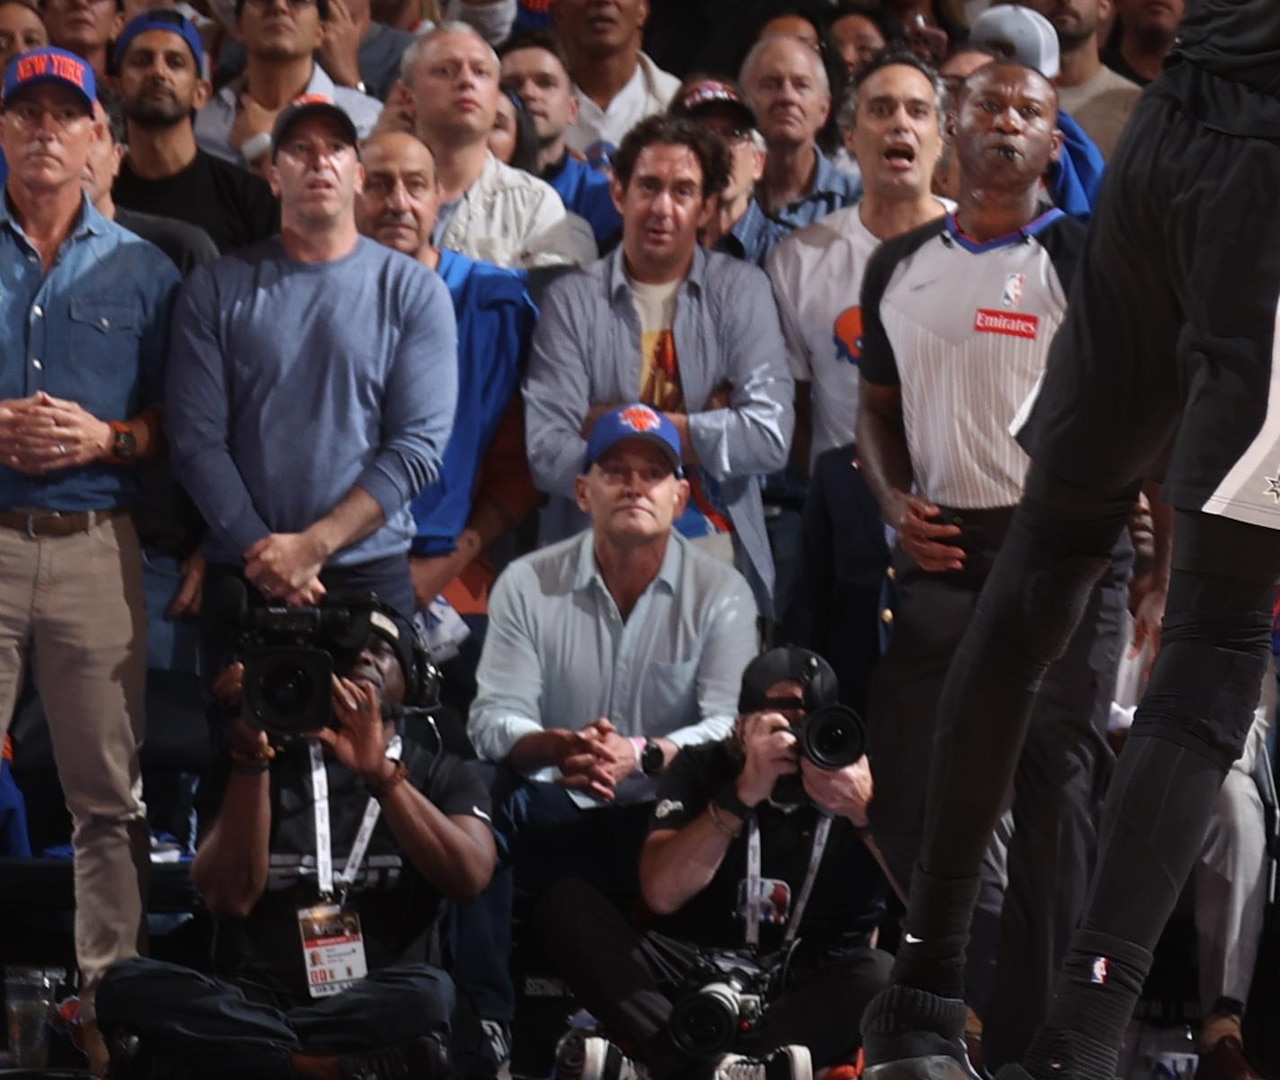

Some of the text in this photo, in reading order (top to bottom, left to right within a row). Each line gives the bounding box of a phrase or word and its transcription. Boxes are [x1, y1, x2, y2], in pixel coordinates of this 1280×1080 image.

[18, 53, 86, 88] NEW YORK
[976, 313, 1037, 333] Emirates
